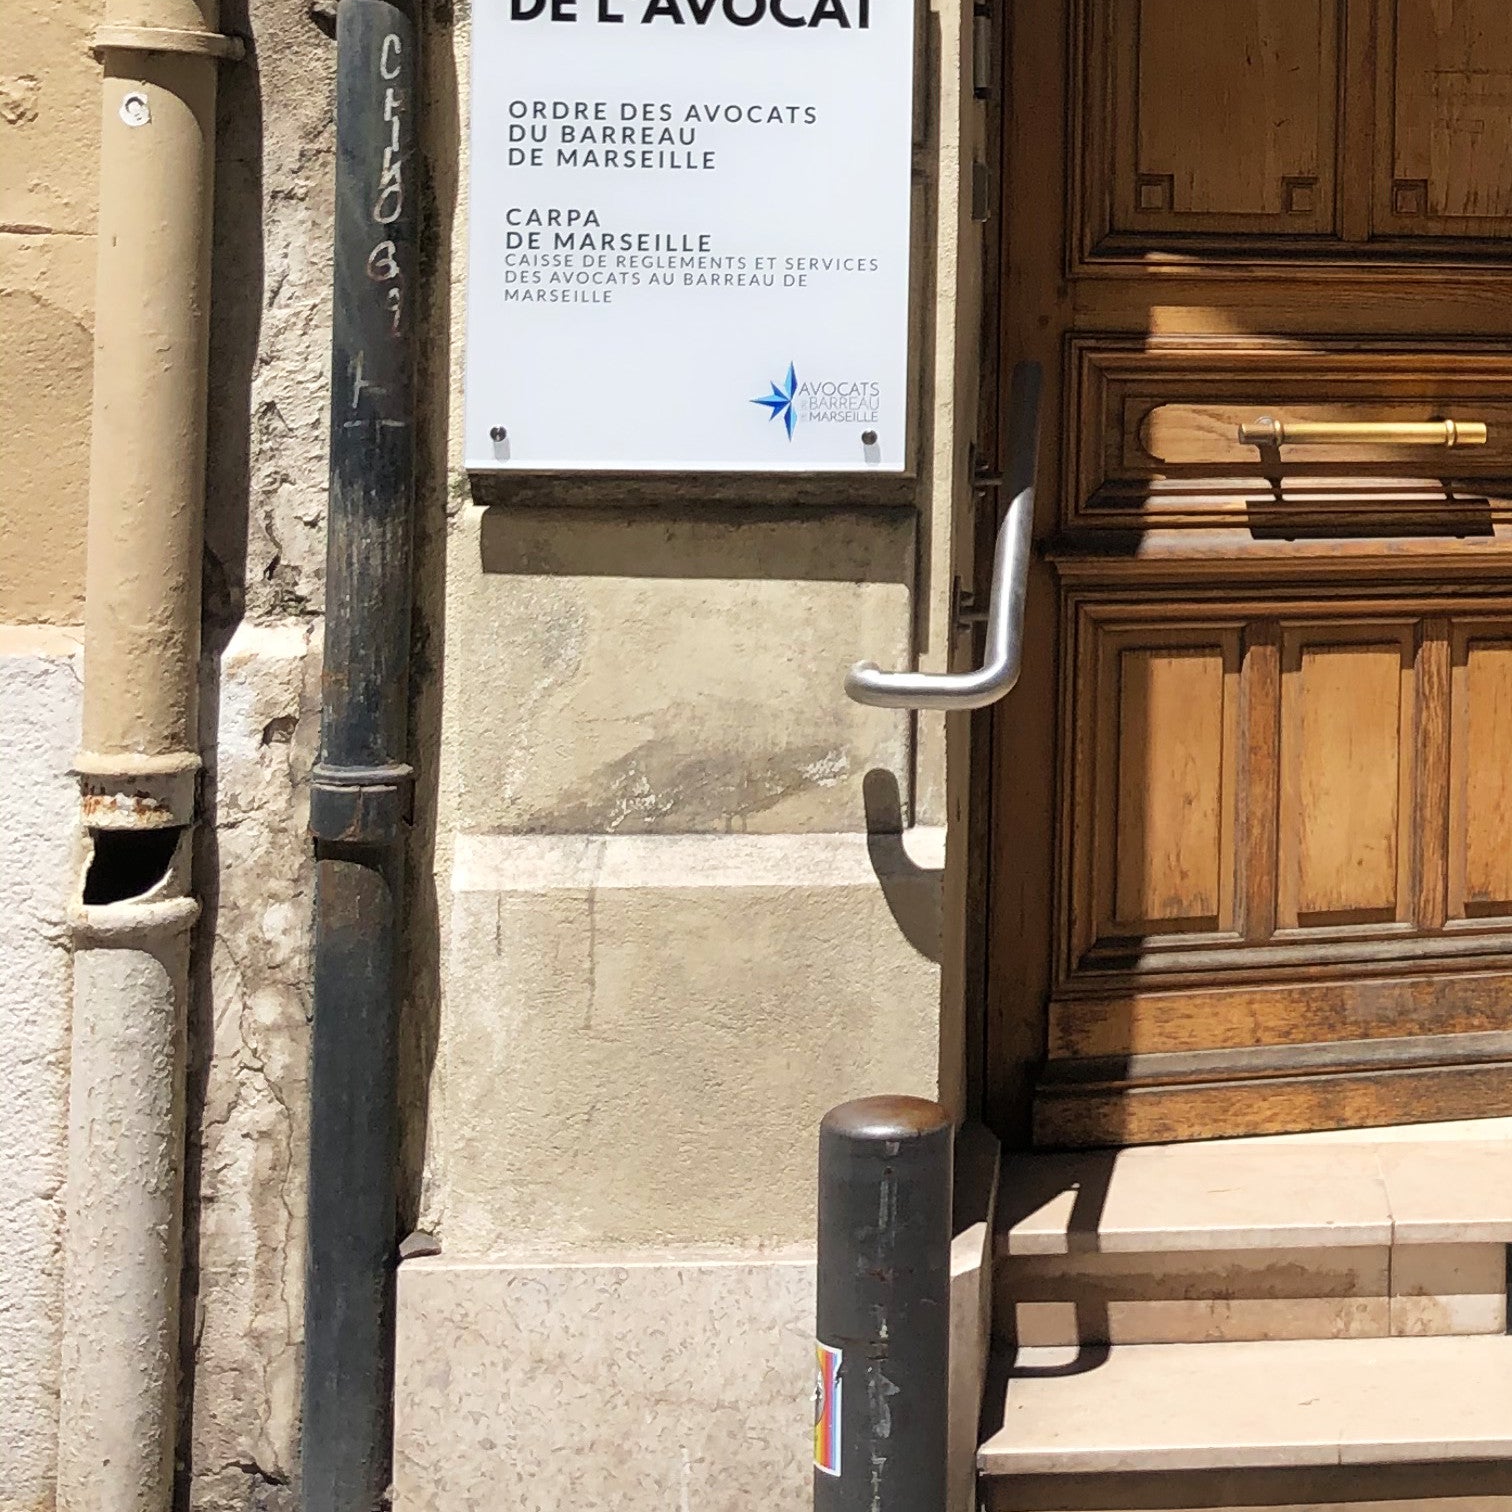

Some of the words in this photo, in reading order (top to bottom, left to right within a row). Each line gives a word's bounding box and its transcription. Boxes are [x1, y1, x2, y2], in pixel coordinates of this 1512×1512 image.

[508, 100, 608, 121] ORDRE
[619, 102, 673, 122] DES
[684, 104, 817, 125] AVOCATS
[508, 124, 548, 143] DU
[560, 125, 696, 146] BARREAU
[508, 148, 544, 167] DE
[556, 149, 716, 170] MARSEILLE
[505, 208, 601, 228] CARPA
[505, 231, 542, 250] DE
[553, 232, 712, 253] MARSEILLE
[504, 253, 574, 268] CAISSE
[583, 254, 607, 269] DE
[616, 255, 747, 270] REGLEMENTS
[754, 257, 777, 271] ET
[784, 257, 879, 272] SERVICES
[505, 270, 542, 285] DES
[549, 271, 641, 286] AVOCATS
[648, 273, 675, 286] AU
[683, 273, 775, 287] BARREAU
[784, 274, 808, 288] DE
[504, 289, 613, 304] MARSEILLE
[798, 381, 880, 397] AVOCATS
[808, 396, 880, 411] BARREAU
[808, 411, 879, 423] MARSEILLE
